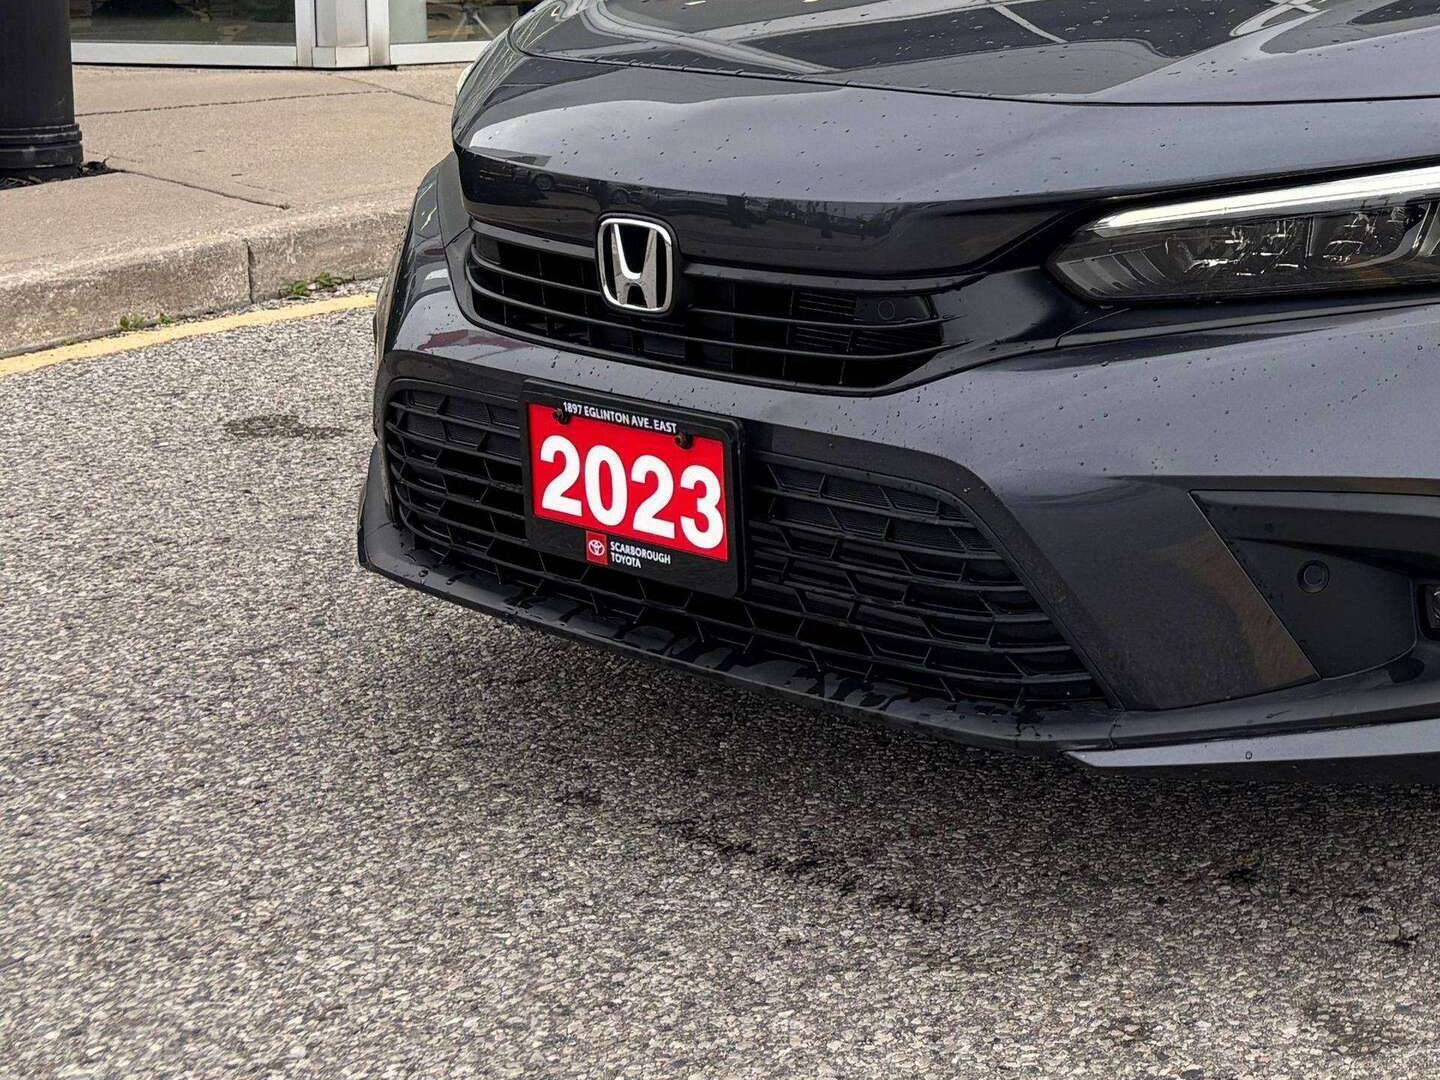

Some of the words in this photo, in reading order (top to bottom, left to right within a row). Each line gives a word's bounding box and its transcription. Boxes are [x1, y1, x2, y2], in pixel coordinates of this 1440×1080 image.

[563, 401, 582, 415] 1897
[583, 405, 630, 425] EGLINTON
[631, 415, 653, 429] AVE.
[653, 420, 677, 434] EAST
[540, 435, 724, 550] 2023
[610, 541, 671, 565] SCARBOROUGH
[610, 551, 642, 569] TOYOTA
